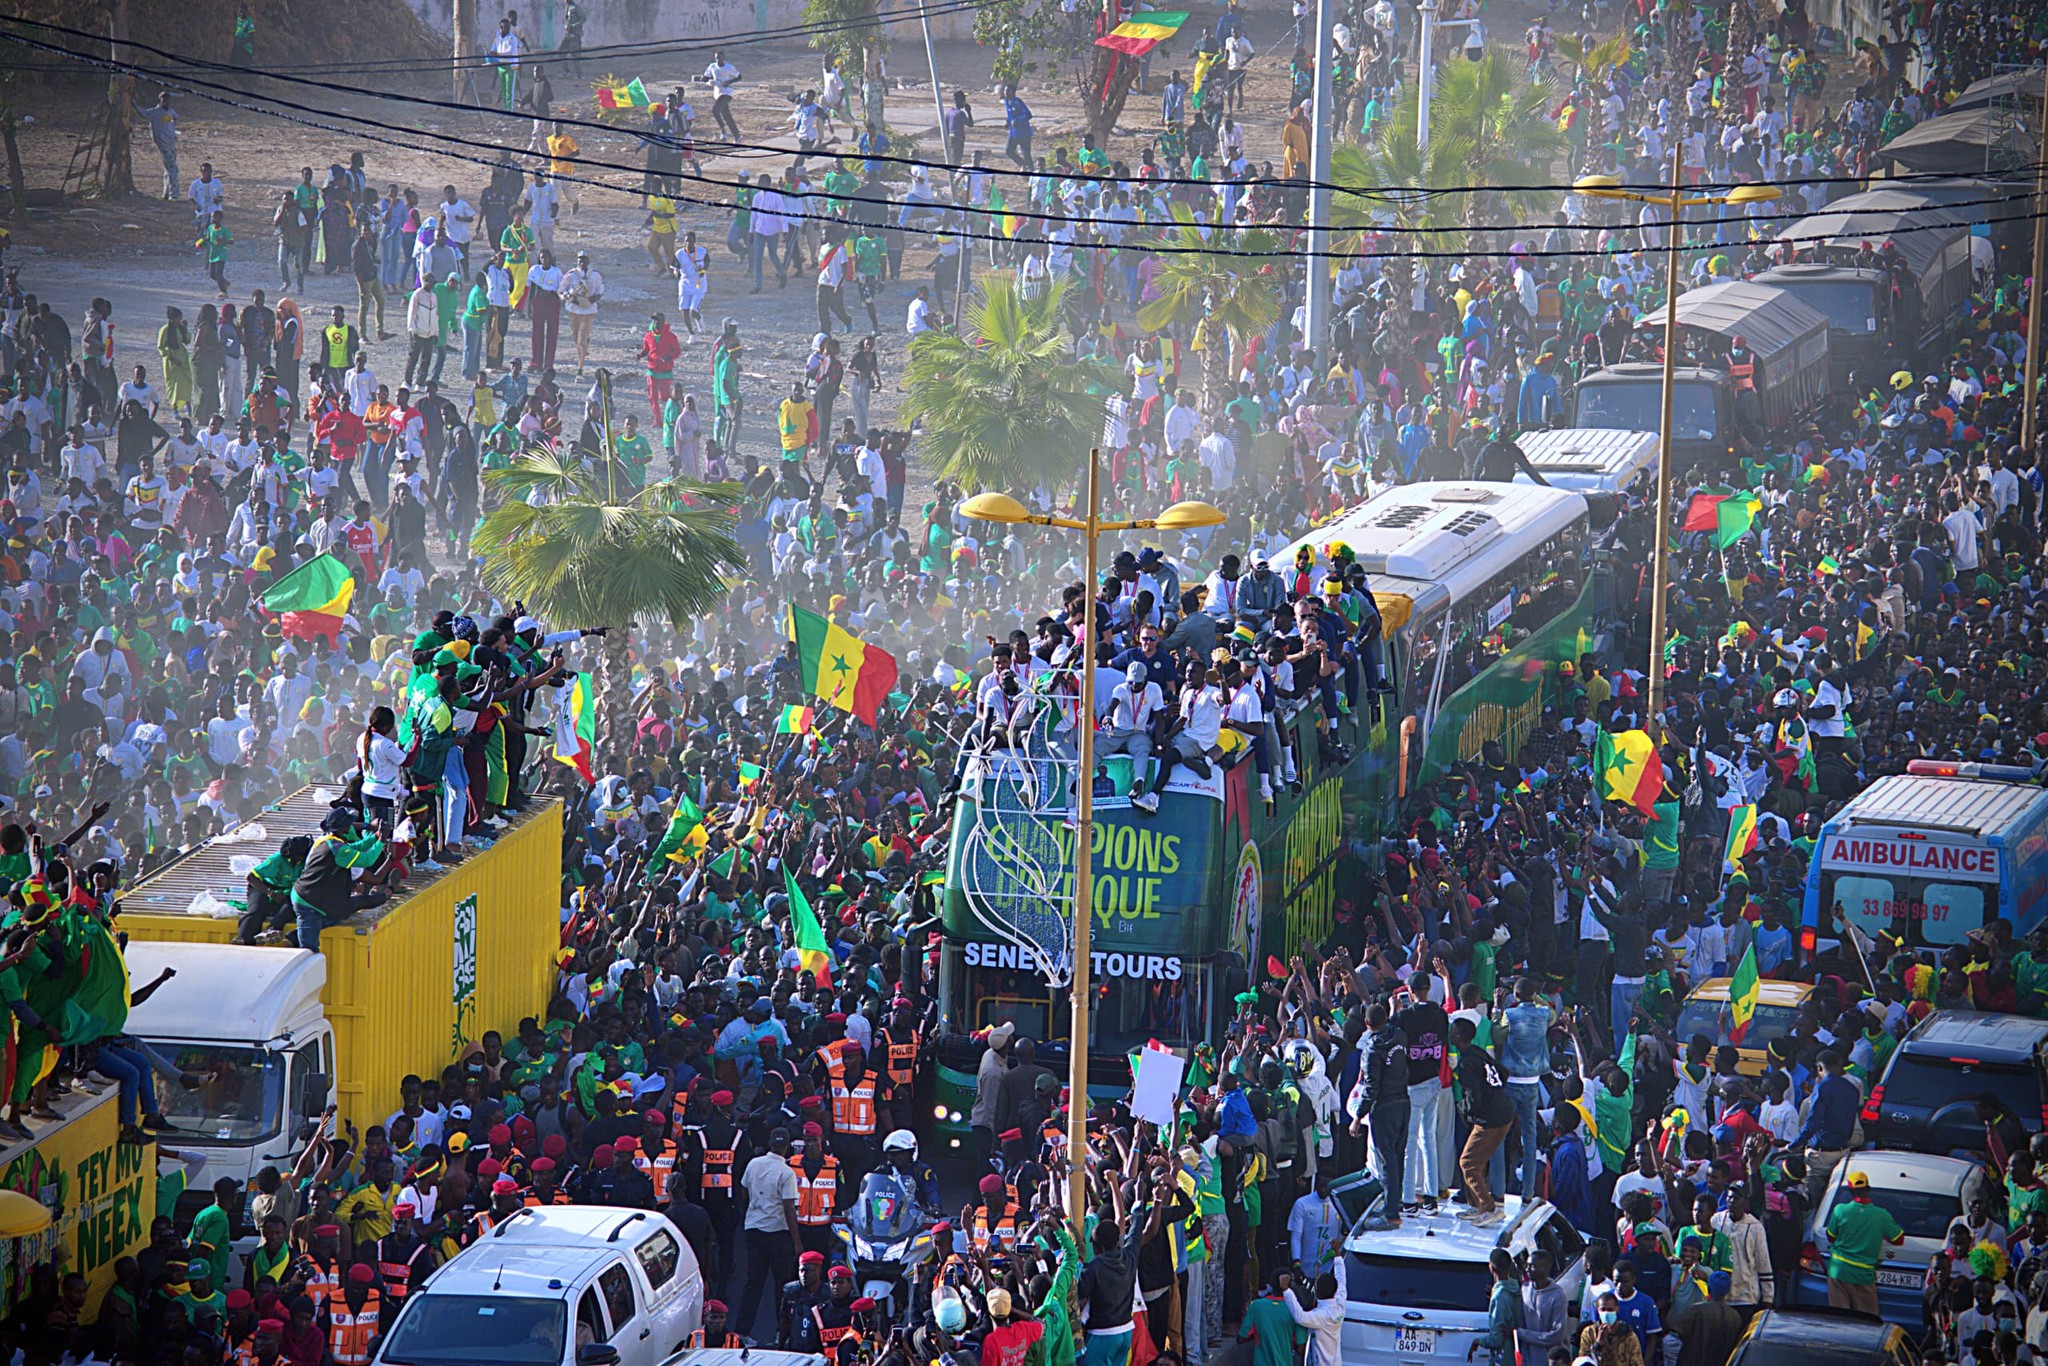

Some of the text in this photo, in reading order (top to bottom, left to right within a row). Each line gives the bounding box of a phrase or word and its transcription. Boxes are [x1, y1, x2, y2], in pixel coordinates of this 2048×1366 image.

[1831, 839, 1996, 873] AMBULANCE
[1862, 898, 1950, 922] 33 869 98 97
[891, 1046, 915, 1056] POLICE
[853, 1090, 873, 1098] POLICE
[704, 1151, 731, 1162] POLICE
[77, 1145, 113, 1203] TEY
[874, 1191, 896, 1199] POLICE
[77, 1176, 143, 1276] NEEX
[1317, 1226, 1329, 1240] 14
[379, 1262, 410, 1276] POLICE
[357, 1312, 379, 1322] POLICE
[820, 1327, 850, 1341] POLIC
